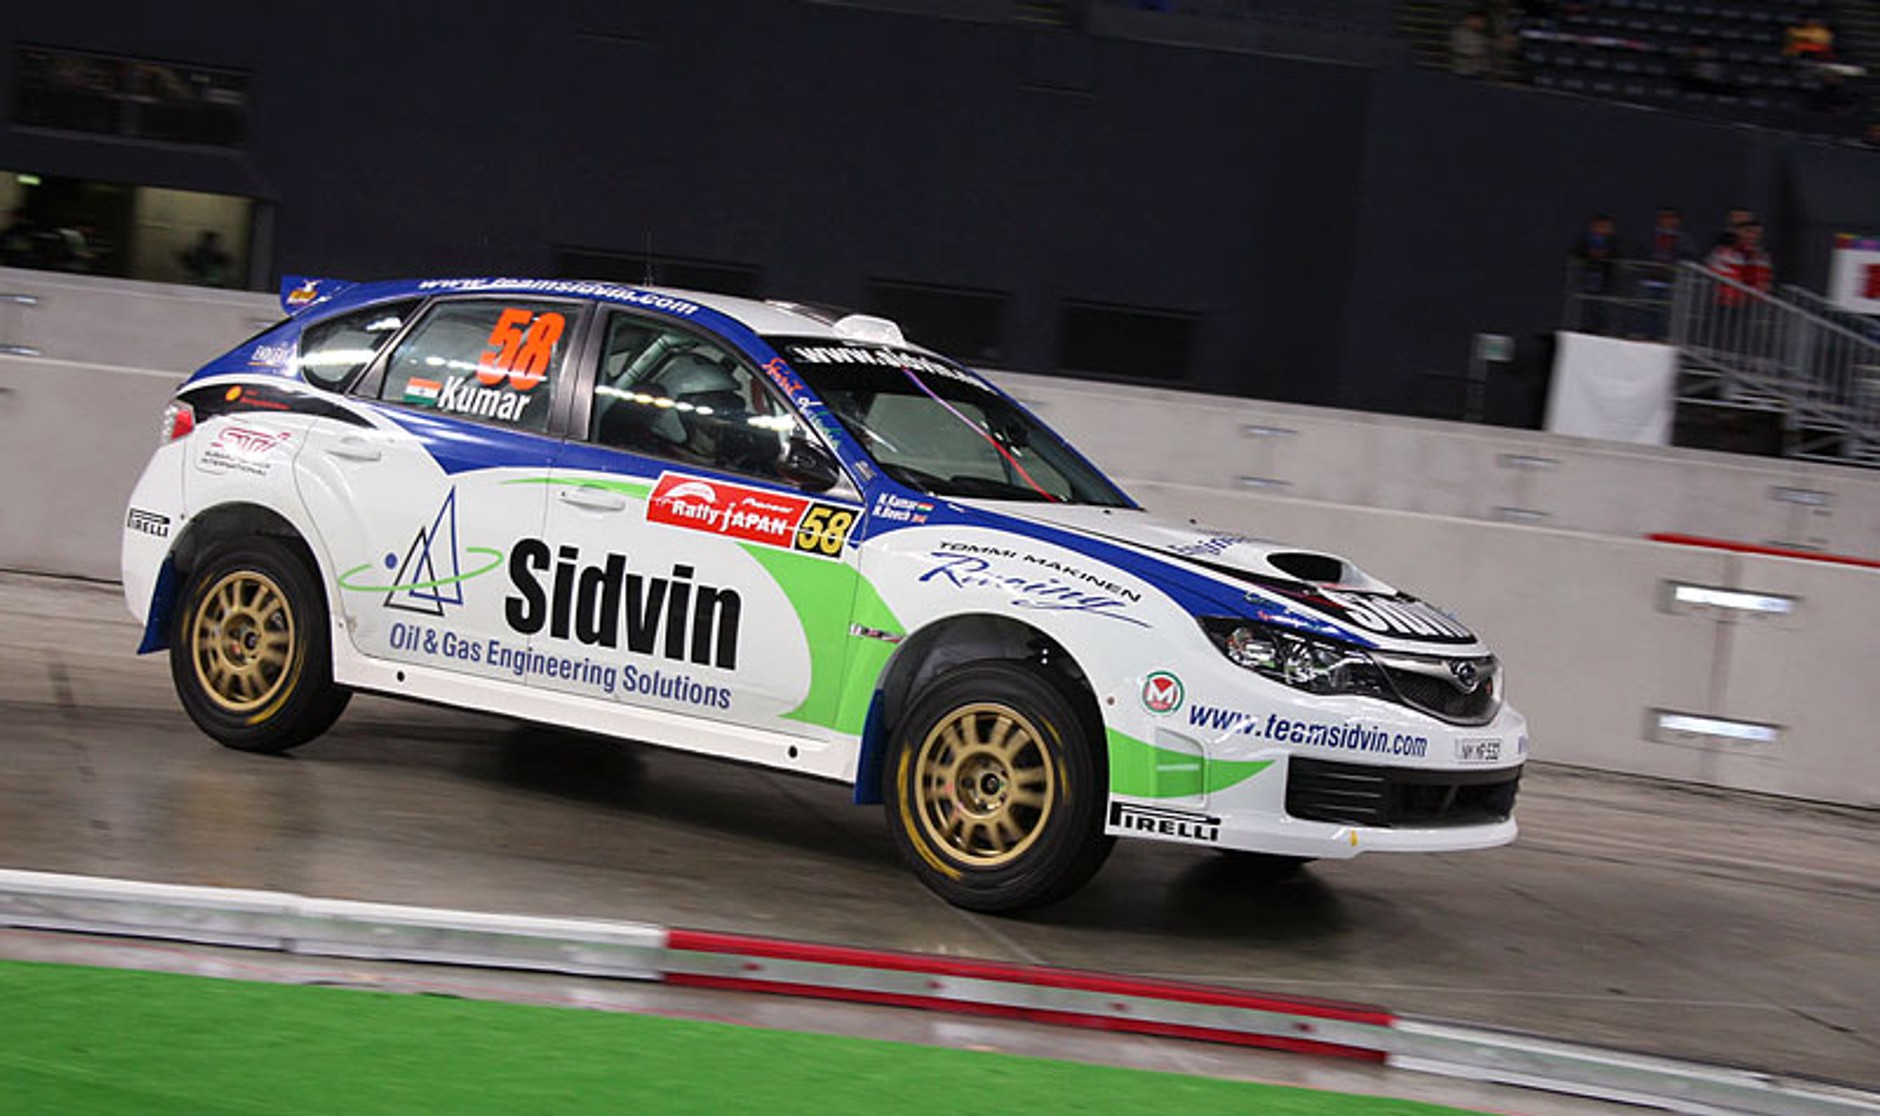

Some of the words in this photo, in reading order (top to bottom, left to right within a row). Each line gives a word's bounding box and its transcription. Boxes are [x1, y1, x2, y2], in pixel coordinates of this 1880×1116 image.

[476, 308, 565, 391] 58
[437, 376, 530, 423] Kumar
[671, 499, 718, 525] Rally
[798, 506, 852, 555] 58
[940, 541, 1017, 558] TOMMI
[1023, 554, 1142, 603] MAKINEN
[505, 538, 742, 670] Sidvin
[389, 622, 420, 652] Oil
[424, 635, 439, 655] &
[442, 632, 481, 663] Gas
[486, 646, 616, 693] Engineering
[623, 668, 731, 709] Solutions
[1188, 703, 1428, 758] www.teamsidvin.com
[1108, 801, 1221, 842] PIRELLI
